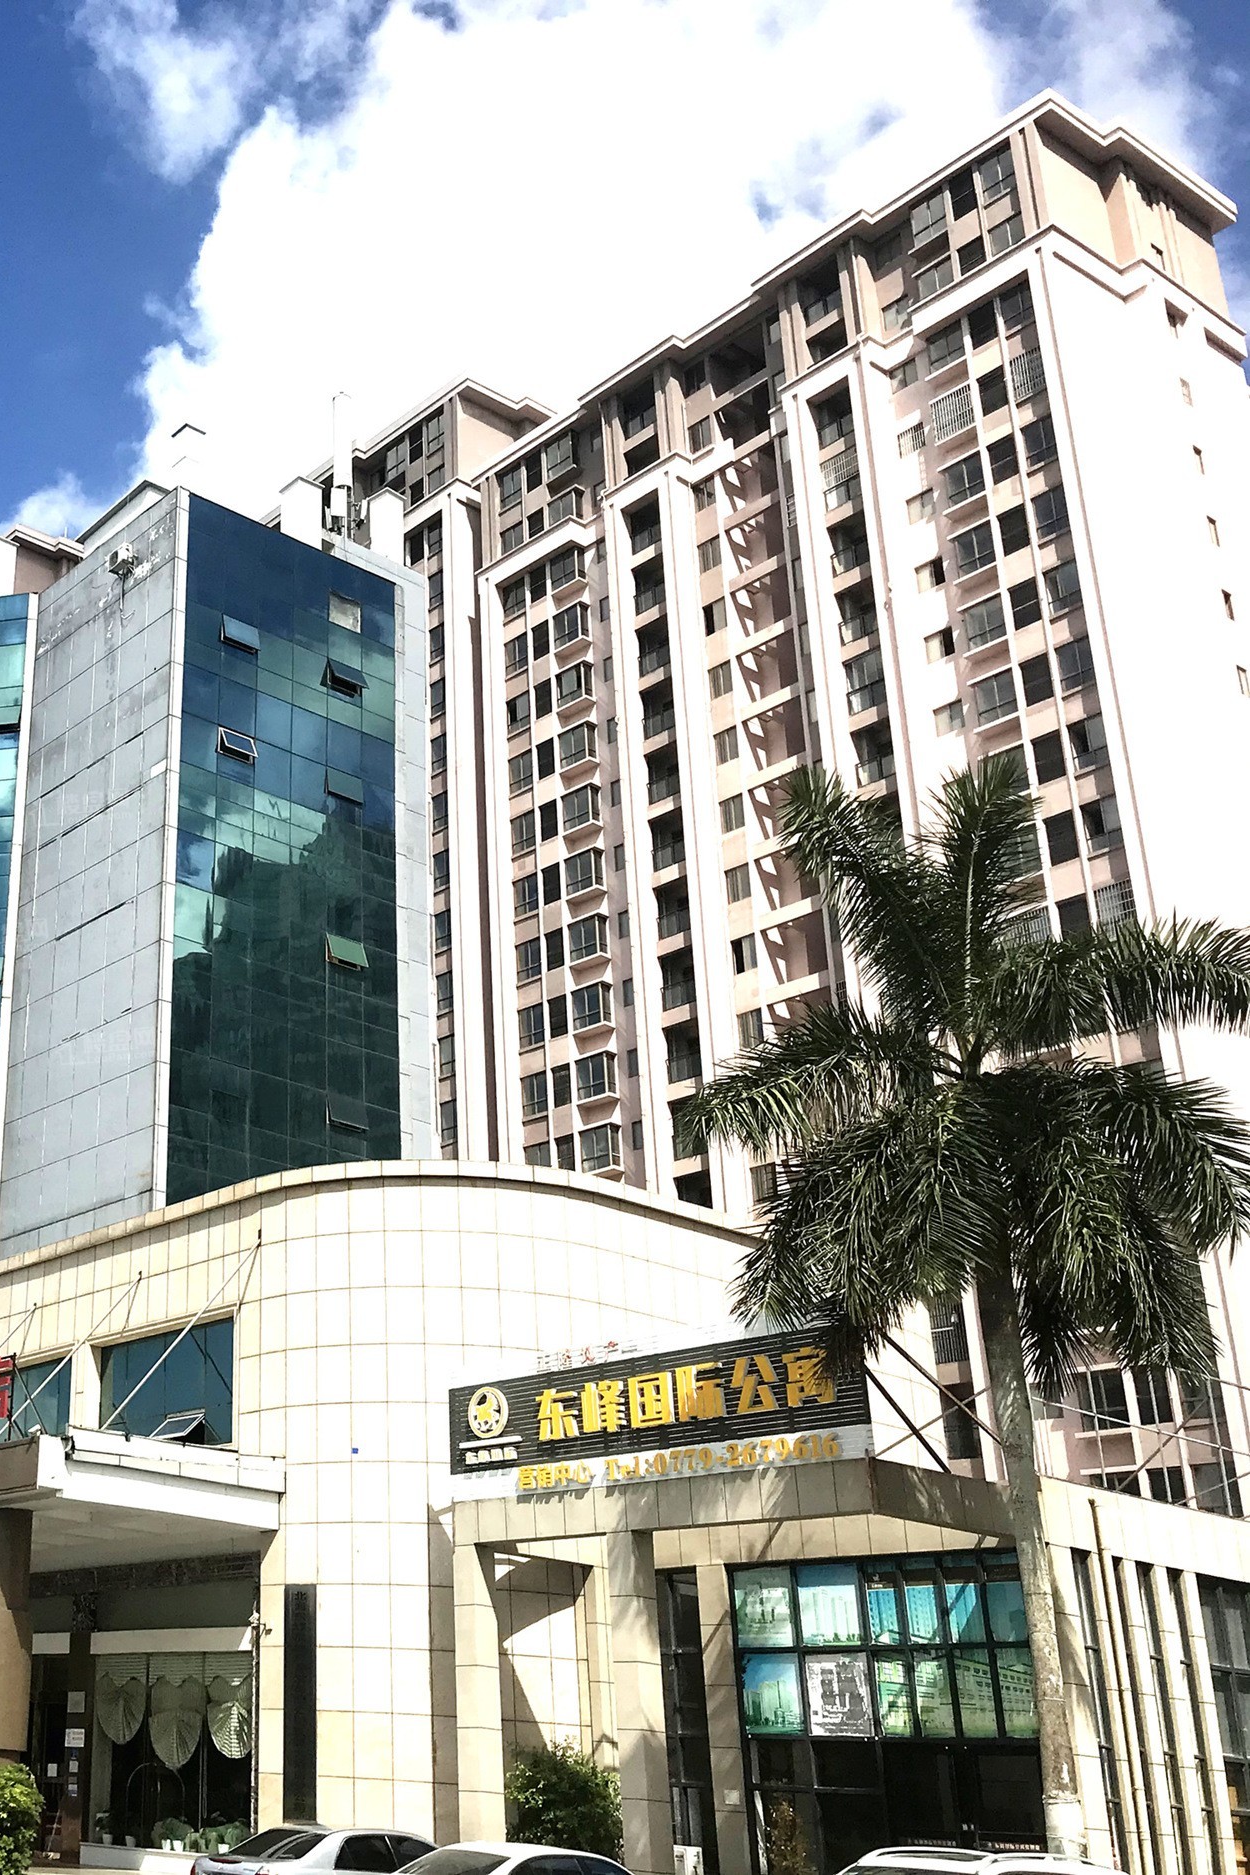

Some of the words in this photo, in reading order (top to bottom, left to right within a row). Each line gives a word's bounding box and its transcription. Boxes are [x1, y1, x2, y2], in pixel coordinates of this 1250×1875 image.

[534, 1346, 838, 1441] 东峰国际公寓
[517, 1460, 593, 1490] 营销中心
